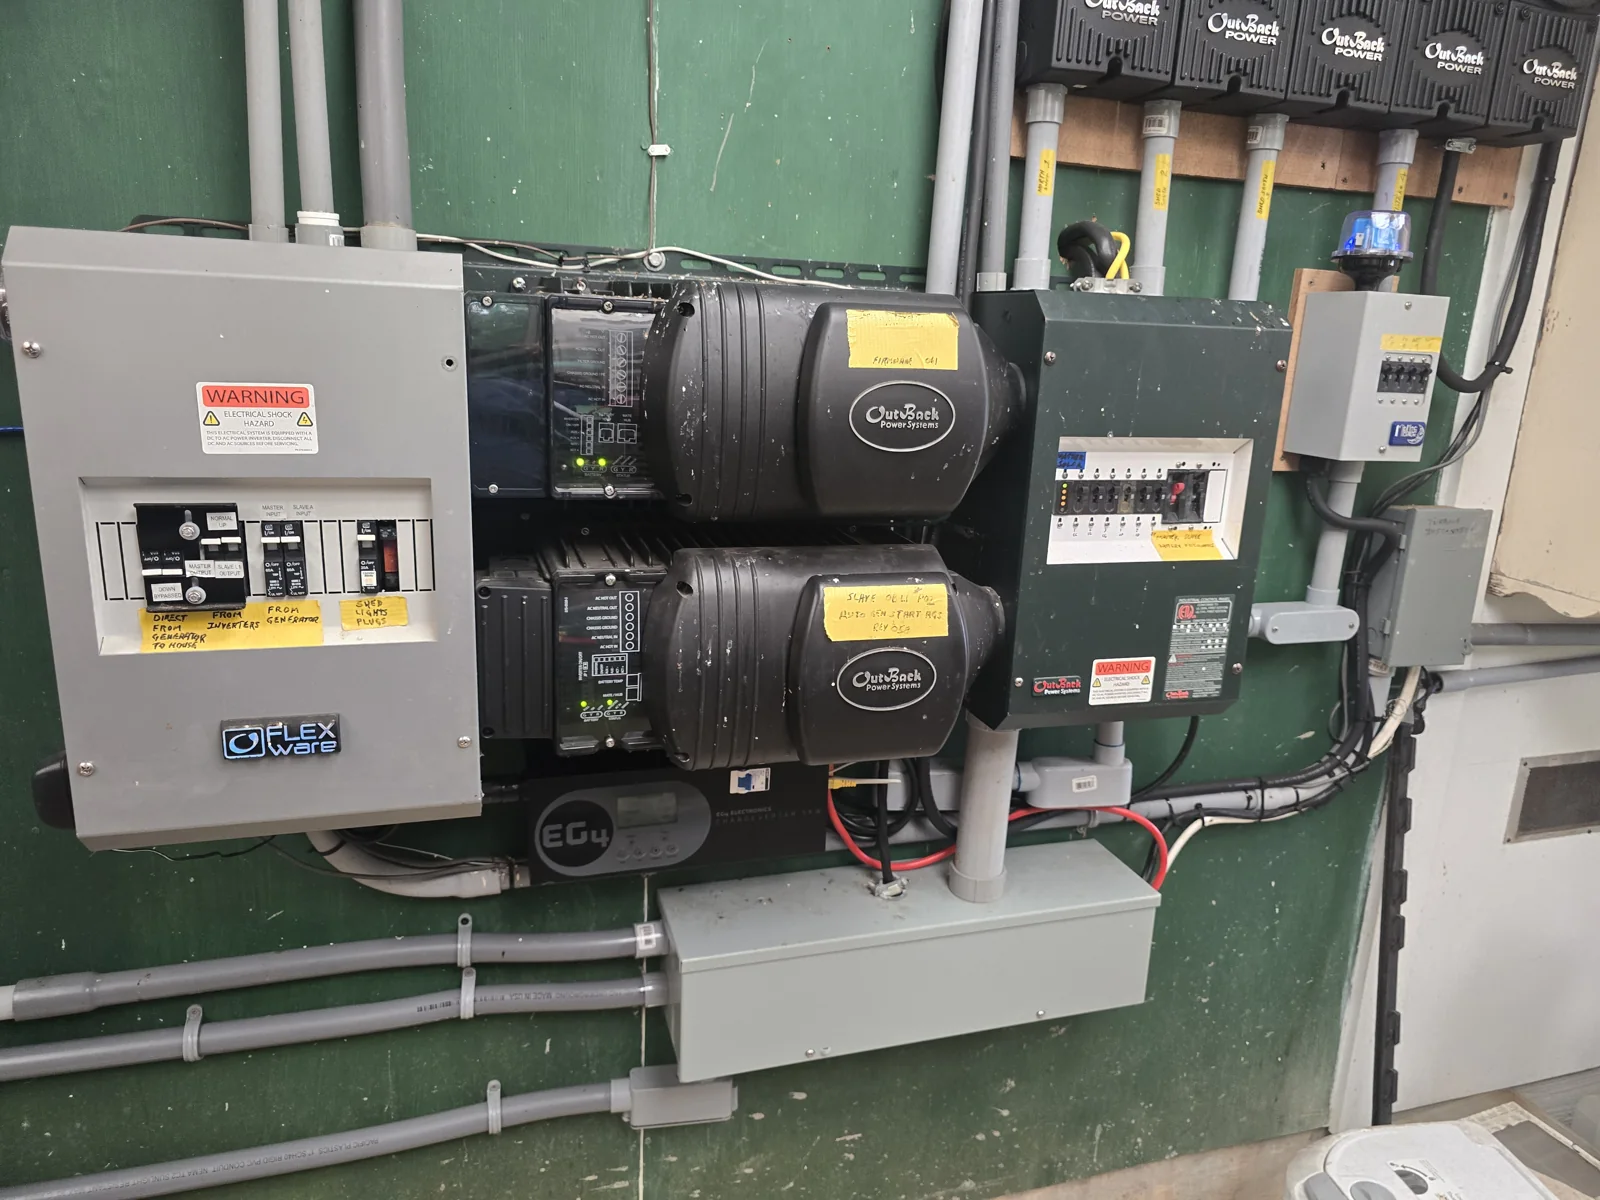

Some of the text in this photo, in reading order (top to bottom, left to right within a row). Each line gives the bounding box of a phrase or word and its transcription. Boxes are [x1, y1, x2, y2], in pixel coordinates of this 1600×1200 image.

[1101, 10, 1158, 25] POWER
[1208, 13, 1279, 37] OutBack
[1225, 30, 1277, 45] POWER
[1321, 28, 1384, 53] OutBack
[1334, 47, 1382, 61] POWER
[1425, 42, 1484, 66] OutBack
[1437, 61, 1482, 75] POWER
[1523, 58, 1577, 81] OutBack
[1534, 76, 1575, 89] POWER
[206, 390, 304, 404] WARNING
[866, 403, 939, 423] OutBack
[880, 420, 939, 430] Power Systems
[847, 593, 876, 603] SLAVE
[356, 600, 382, 609] SHED
[266, 616, 319, 624] GENERATOR
[889, 610, 921, 619] START
[207, 621, 260, 630] INVERTERS
[356, 618, 386, 626] PLUGS
[152, 632, 207, 643] GENERATOR
[1098, 662, 1149, 673] WARNING
[852, 667, 921, 687] OutBack
[891, 683, 921, 691] Systems
[1034, 678, 1081, 692] OutBack
[266, 722, 336, 742] FLEX
[731, 806, 771, 815] ELECTRONICS
[542, 821, 609, 848] EG4
[319, 1144, 351, 1154] PLASTICS
[353, 1139, 379, 1148] PACIFIC
[264, 1155, 282, 1164] RIGID
[284, 1150, 306, 1160] SCH40
[212, 1161, 245, 1172] CONDUIT
[188, 1168, 208, 1177] NEMA
